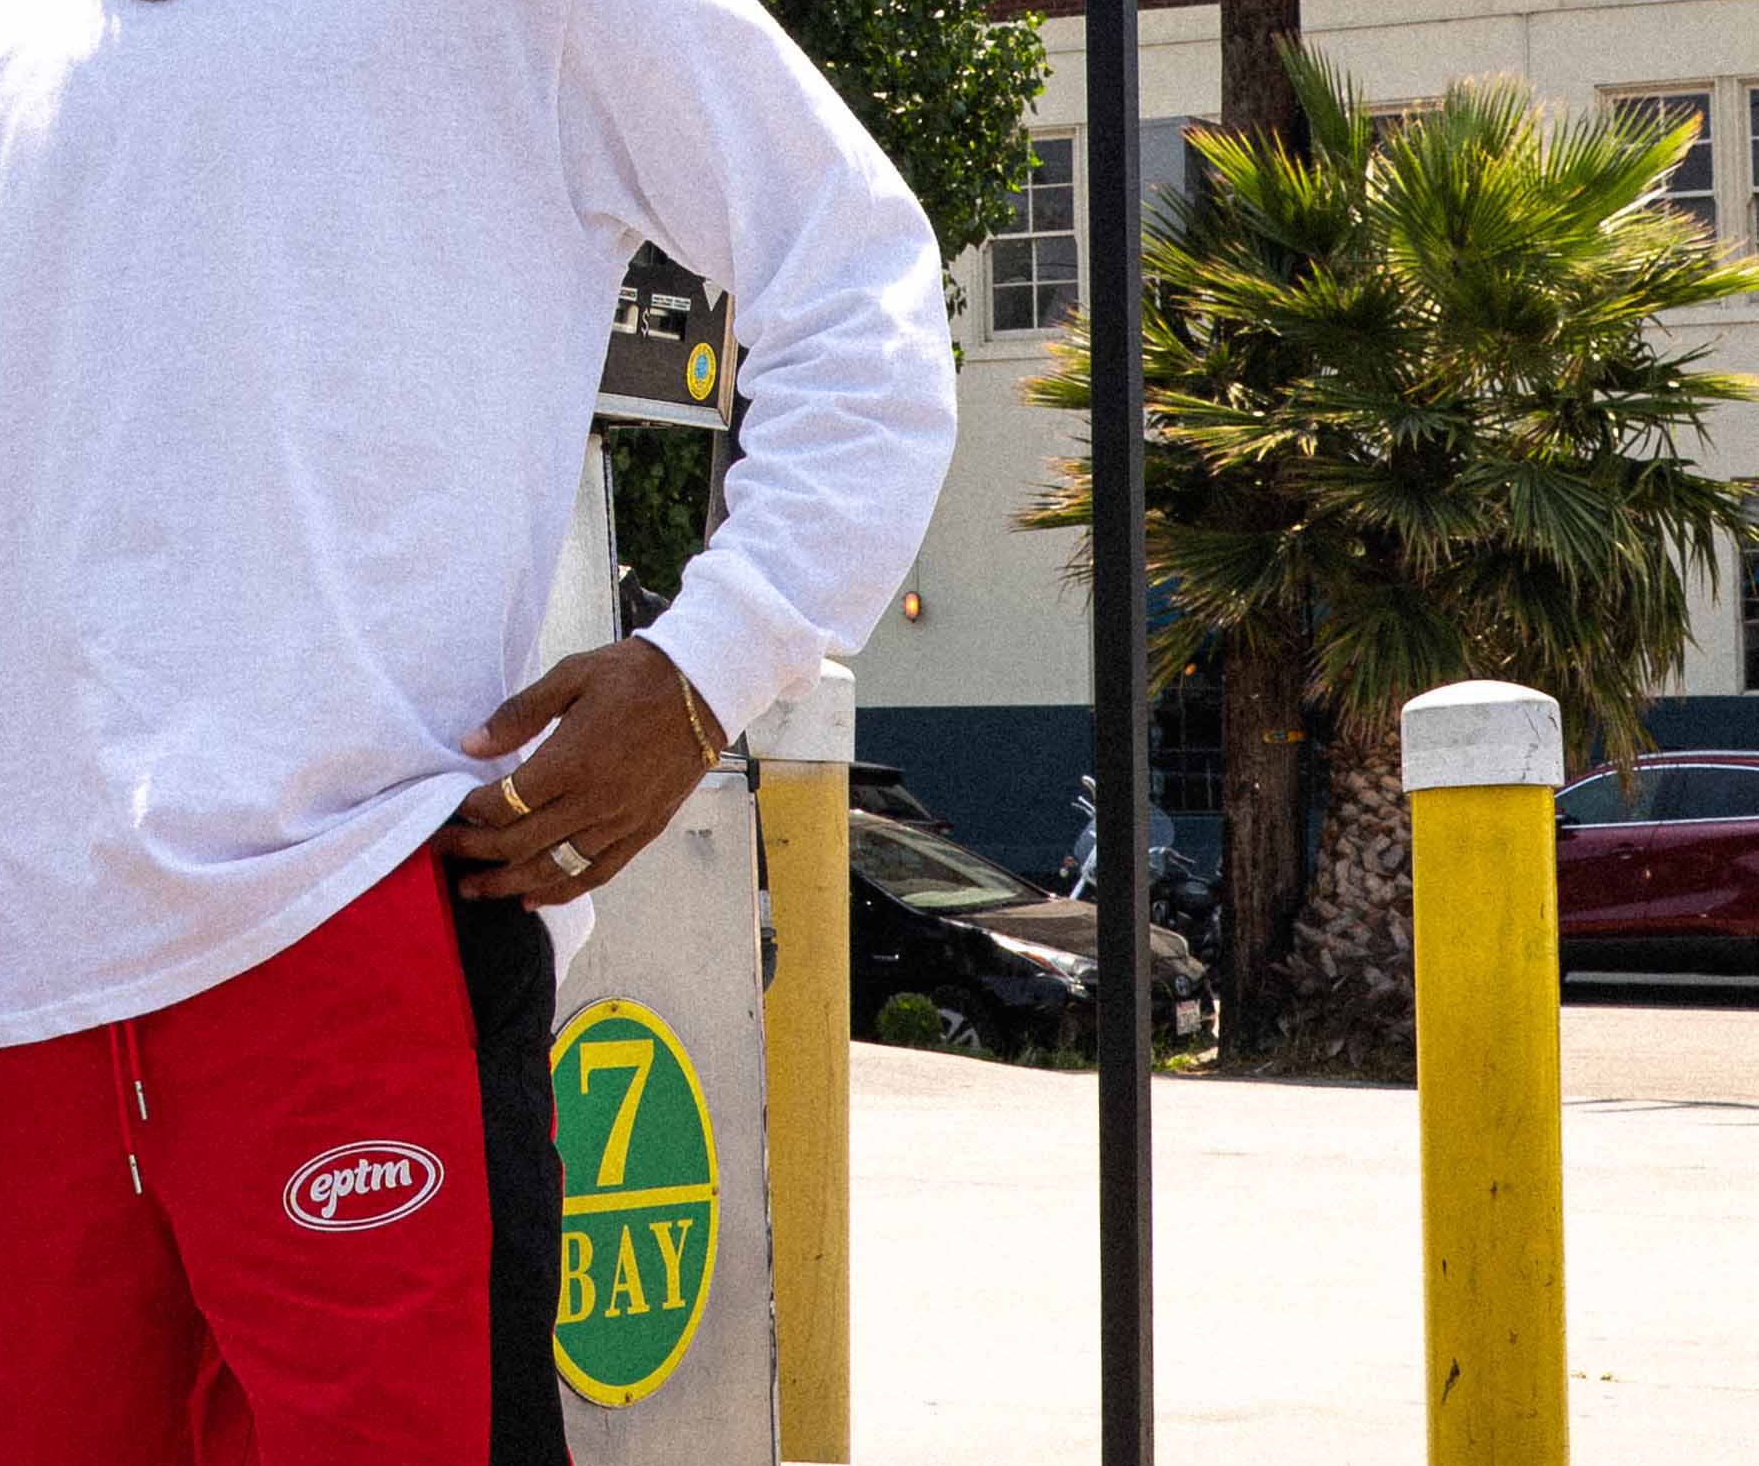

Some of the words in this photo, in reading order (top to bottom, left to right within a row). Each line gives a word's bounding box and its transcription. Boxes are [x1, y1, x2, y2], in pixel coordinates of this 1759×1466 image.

[580, 1039, 654, 1187] 7
[309, 1158, 413, 1219] eptm
[556, 1219, 693, 1324] BAY
